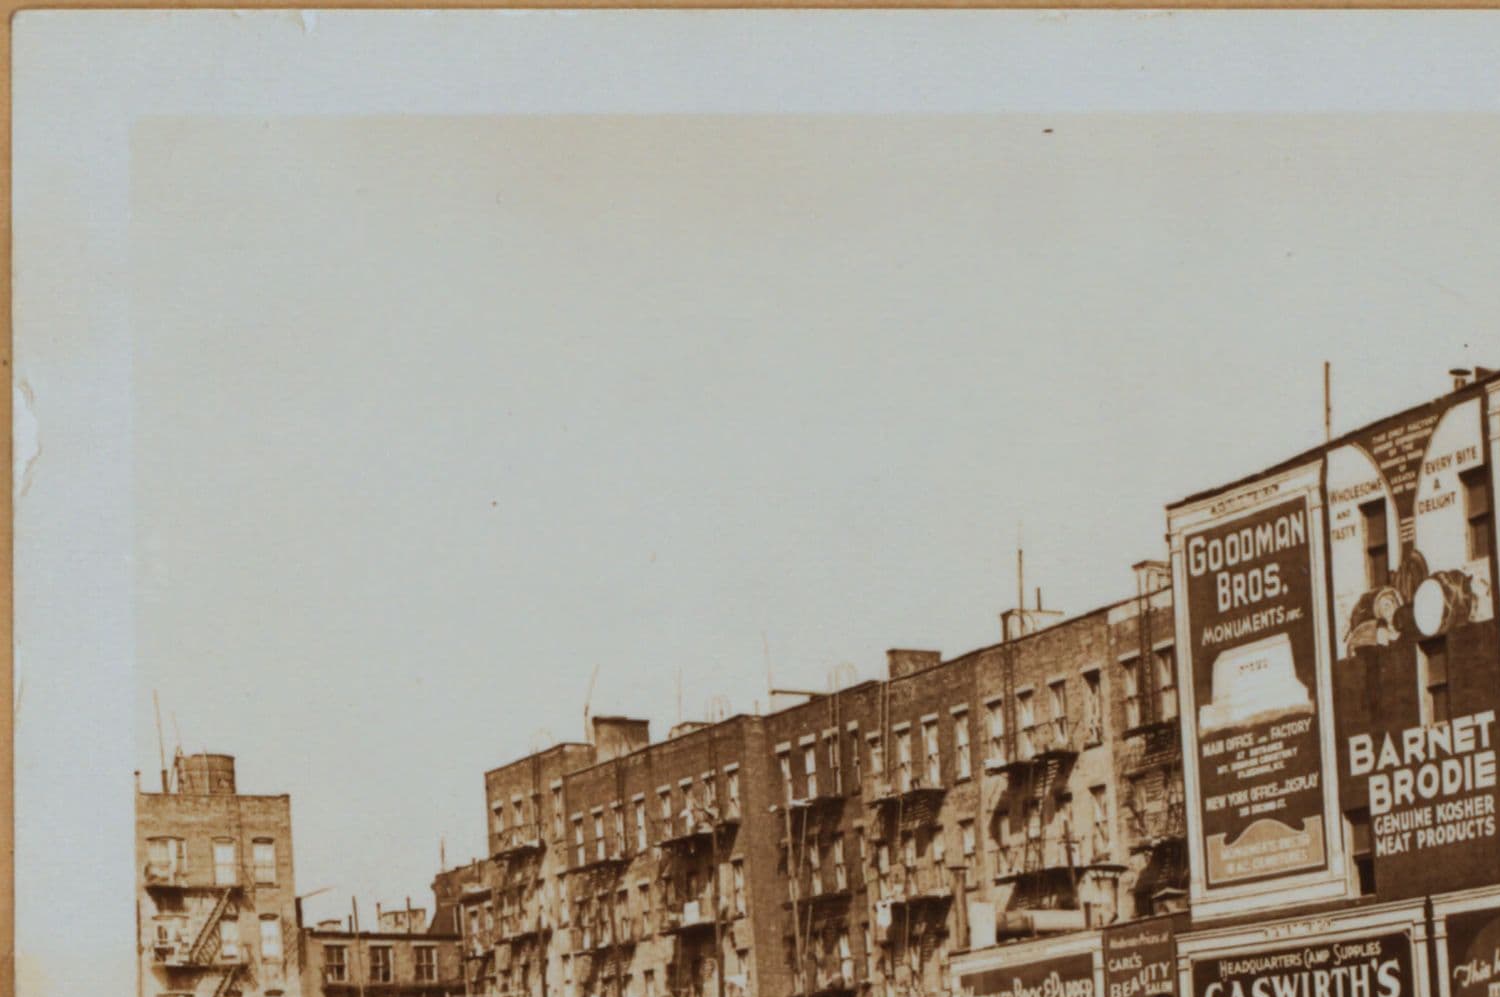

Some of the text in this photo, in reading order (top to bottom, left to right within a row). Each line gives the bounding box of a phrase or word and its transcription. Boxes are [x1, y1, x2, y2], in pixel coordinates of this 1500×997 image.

[1425, 446, 1477, 475] EVERY BITE
[1329, 478, 1383, 504] WHOLESOME
[1418, 491, 1456, 514] DELIGHT
[1433, 477, 1441, 491] A
[1189, 510, 1305, 576] GOODMAN
[1332, 525, 1356, 541] TASTY
[1217, 562, 1288, 612] BROS.
[1202, 606, 1285, 647] MONUMENTS
[1226, 732, 1254, 751] OFFICE
[1270, 717, 1312, 740] FACTORY
[1348, 710, 1496, 776] BARNET
[1206, 794, 1227, 812] NEW
[1227, 788, 1249, 807] YORK
[1250, 782, 1279, 802] OFFICE
[1285, 771, 1319, 793] DISPLAY
[1369, 750, 1497, 816] BRODIE
[1374, 794, 1495, 835] GENUINE KOSHER
[1376, 816, 1496, 858] MEAT PRODUCTS
[1108, 952, 1142, 972] CARL'S
[1219, 940, 1381, 982] HEADQUARTERS CAMP SUPPLIES
[1453, 959, 1492, 988] This
